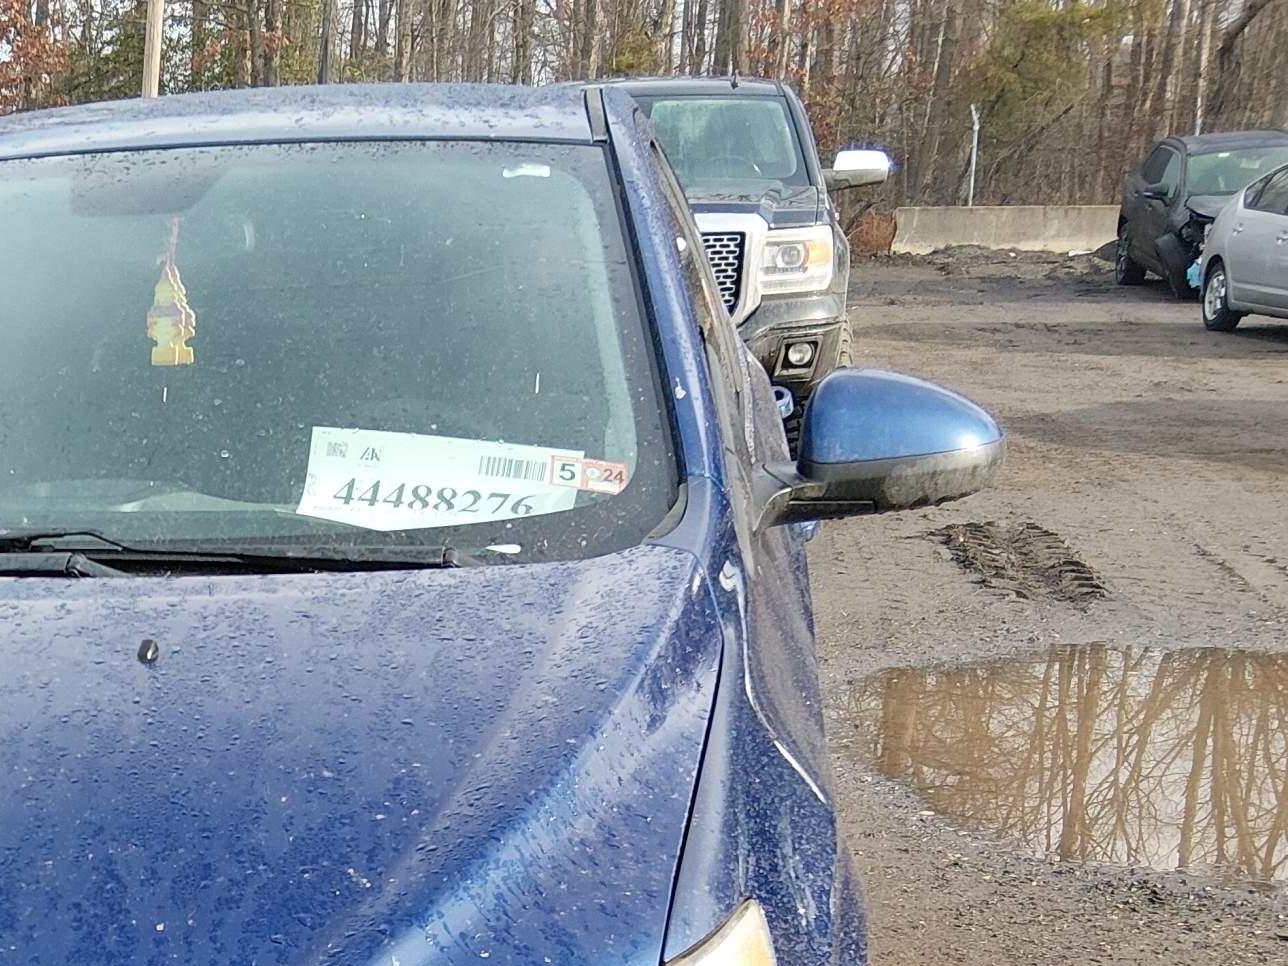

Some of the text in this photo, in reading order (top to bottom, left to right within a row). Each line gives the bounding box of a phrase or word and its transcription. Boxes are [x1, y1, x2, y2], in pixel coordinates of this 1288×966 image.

[559, 463, 624, 484] 5 24
[332, 477, 537, 516] 44488276
